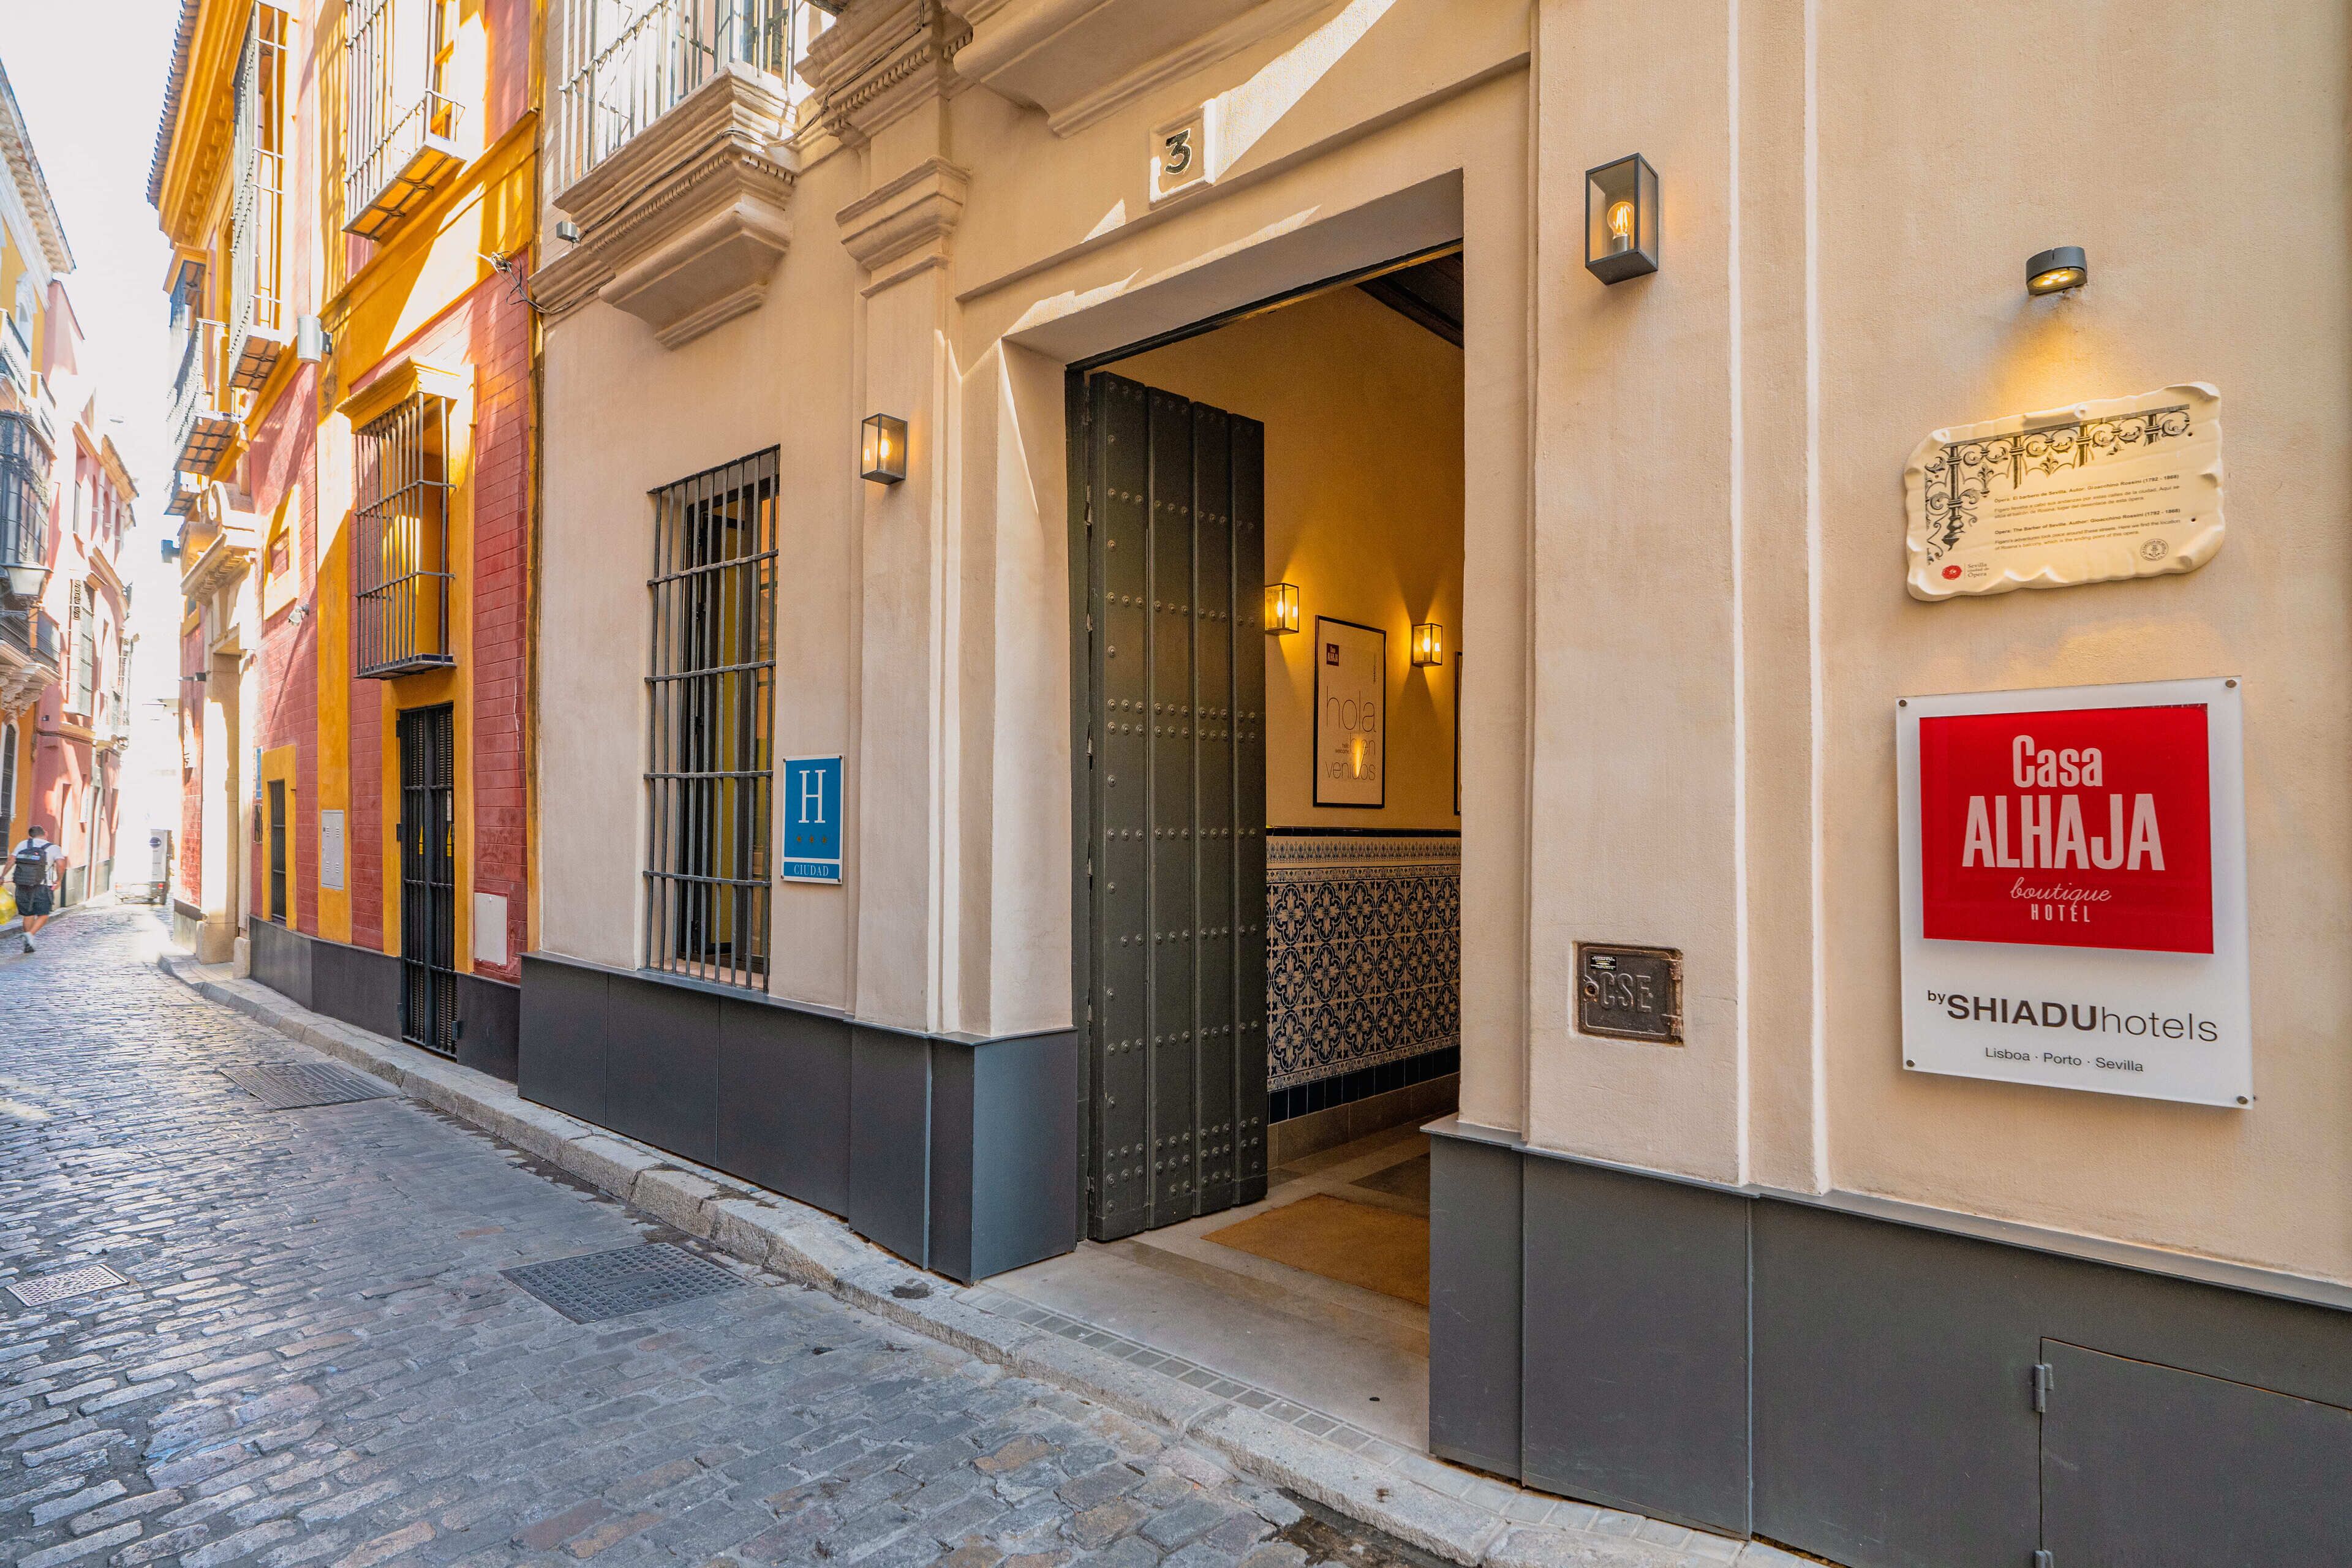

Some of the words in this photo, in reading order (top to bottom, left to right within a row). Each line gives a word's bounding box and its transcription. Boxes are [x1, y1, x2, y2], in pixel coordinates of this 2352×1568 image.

[1164, 128, 1192, 175] 3
[1326, 686, 1376, 732] hola
[2012, 734, 2103, 788] Casa
[798, 769, 826, 823] H
[1962, 793, 2166, 871] ALHAJA
[794, 864, 829, 876] CIUDAD
[2010, 876, 2112, 911] boutique
[2031, 903, 2090, 922] HOTEL
[1985, 1047, 2030, 1062] Lisboa
[2044, 1052, 2082, 1067] Porto
[2095, 1057, 2144, 1072] Sevilla
